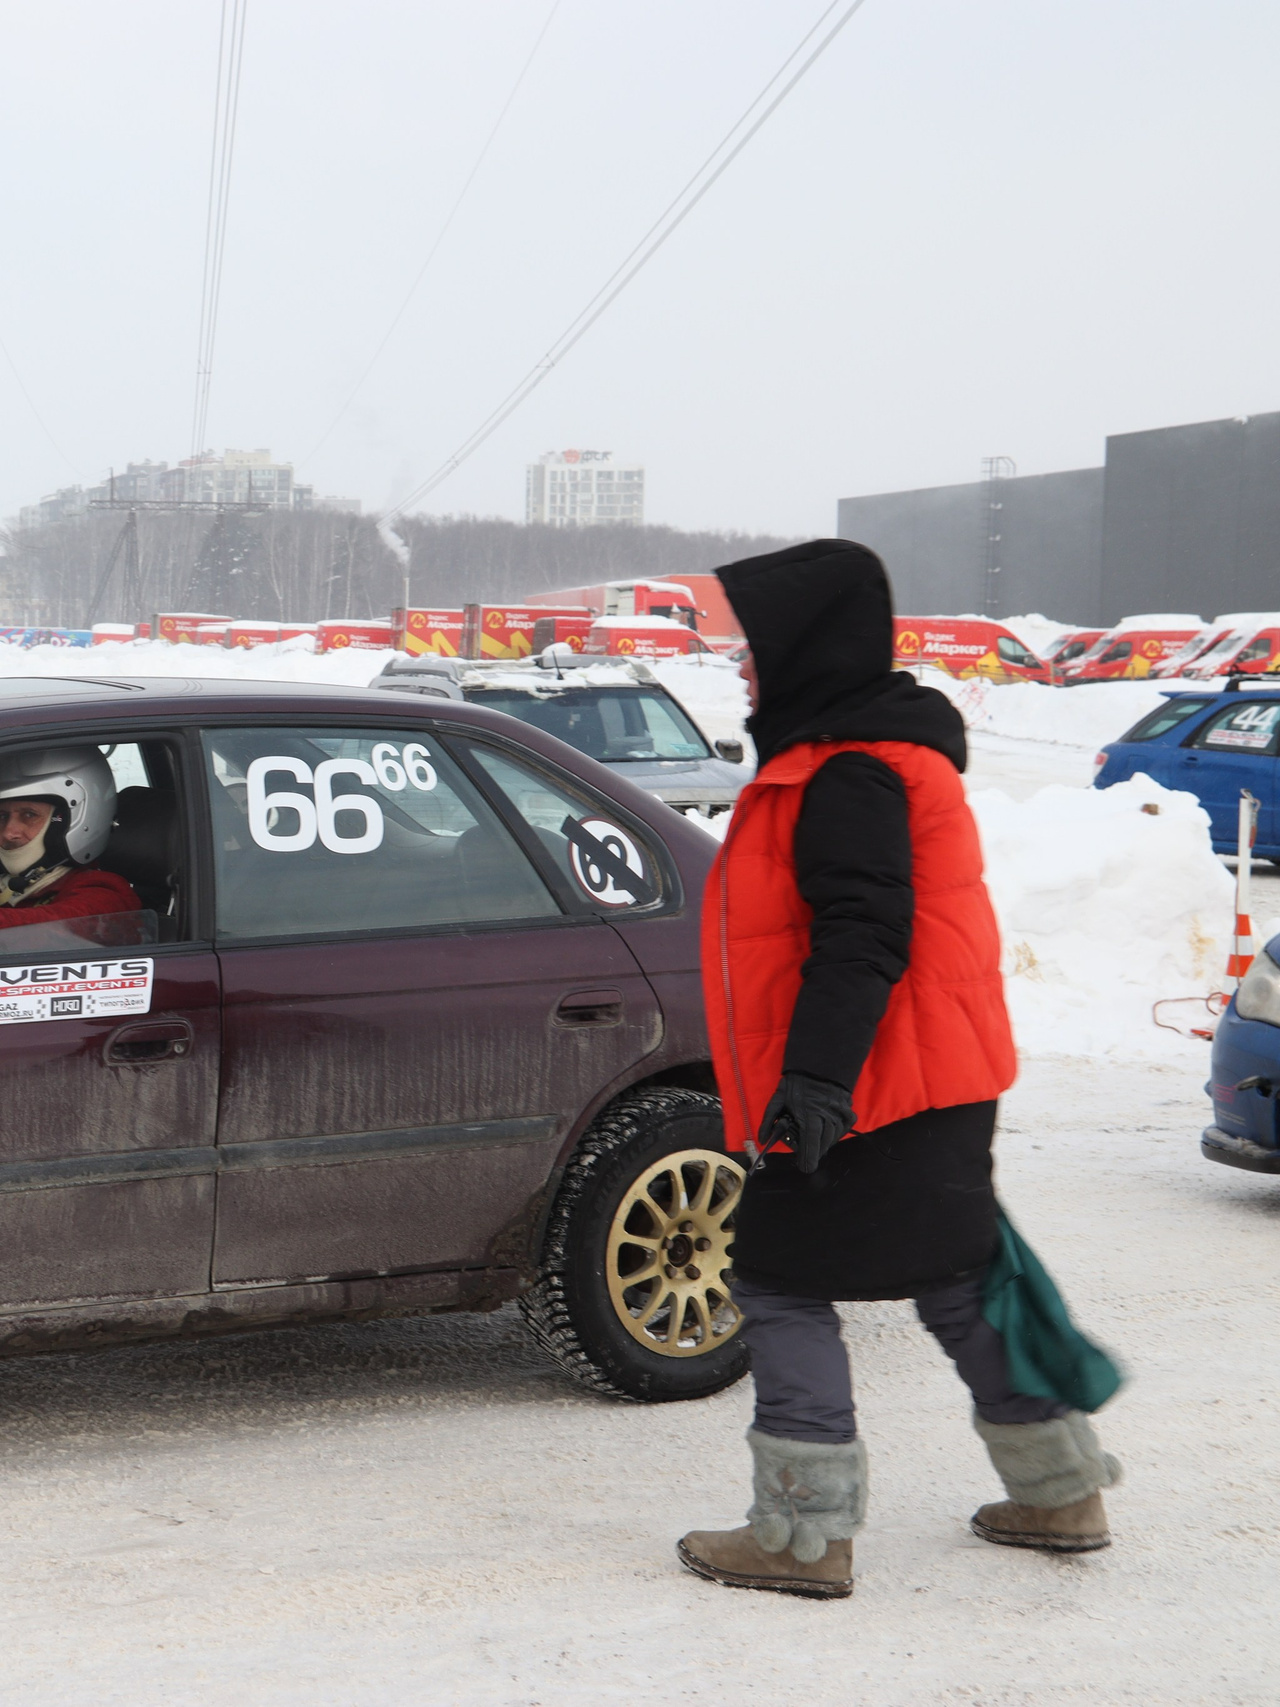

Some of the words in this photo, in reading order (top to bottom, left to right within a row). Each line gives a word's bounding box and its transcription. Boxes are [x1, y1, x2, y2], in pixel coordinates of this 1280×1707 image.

[426, 621, 463, 630] Марке
[504, 619, 535, 630] Мар
[923, 632, 956, 641] Яндекс
[922, 642, 988, 655] Маркет
[1232, 705, 1279, 731] 44
[247, 755, 384, 854] 66
[371, 743, 438, 791] 66
